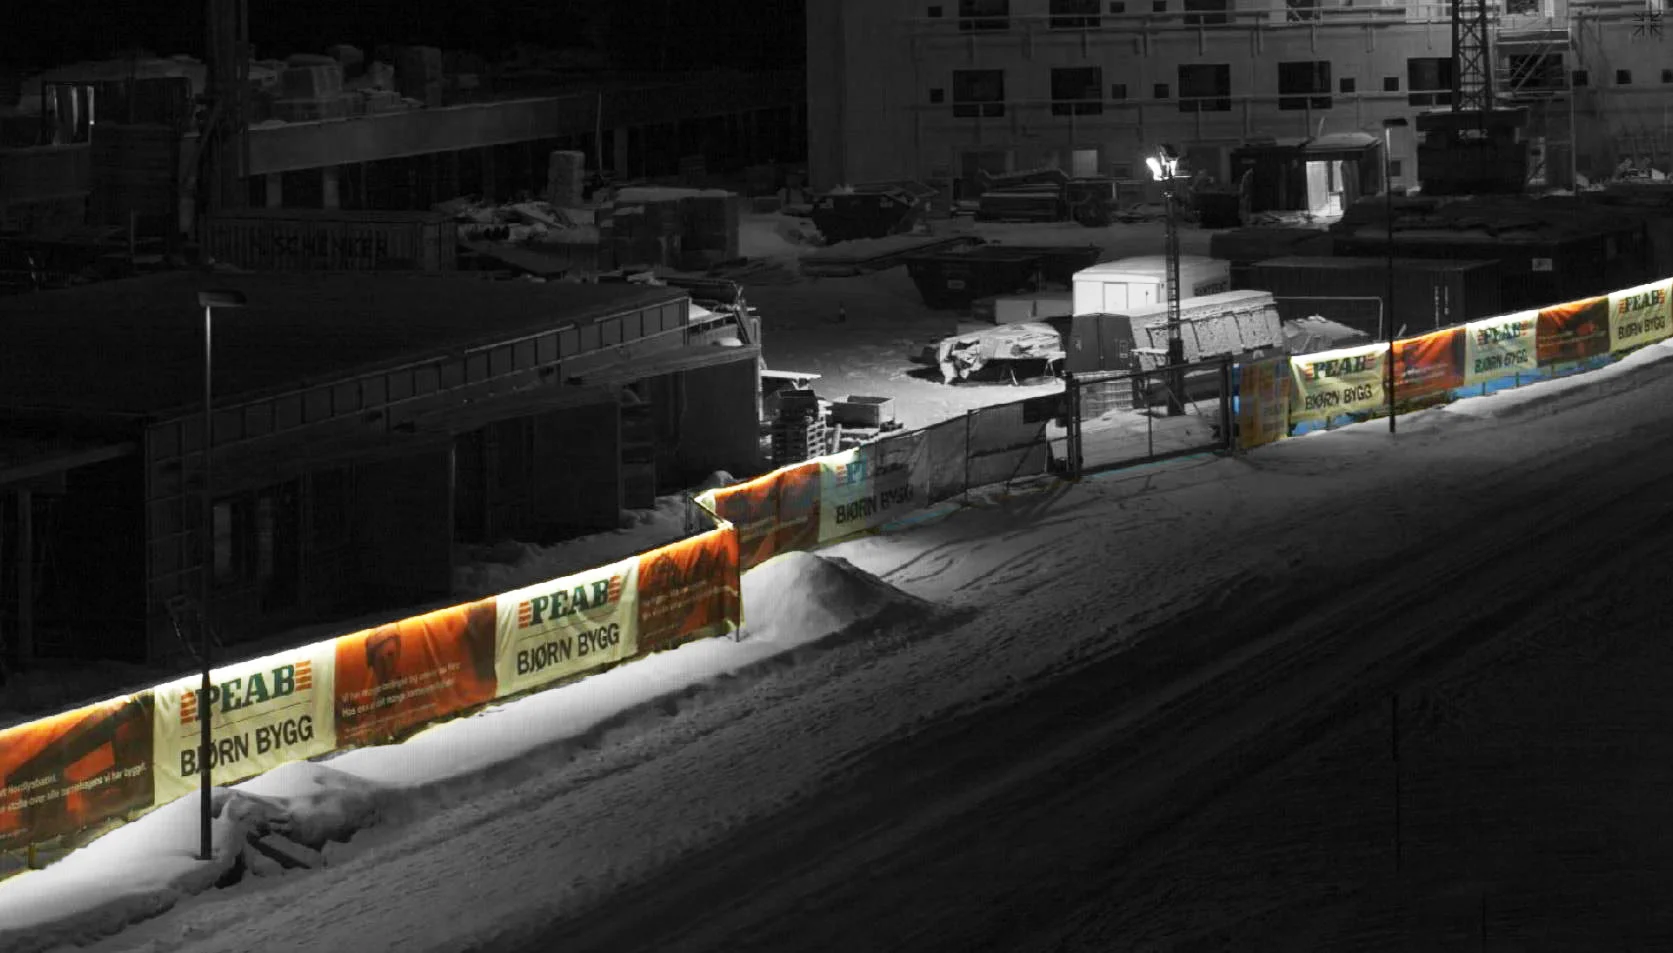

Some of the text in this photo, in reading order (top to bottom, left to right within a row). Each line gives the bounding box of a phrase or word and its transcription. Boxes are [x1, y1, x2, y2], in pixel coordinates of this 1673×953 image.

[274, 231, 389, 257] SCHENKER
[1625, 289, 1659, 312] PEAB
[1313, 356, 1367, 380] PEAB
[1343, 383, 1373, 404] BYGG
[529, 579, 609, 627] PEAB
[517, 622, 620, 677] BJØRN BYGG
[194, 663, 295, 722] PEAB
[180, 731, 249, 777] BJØRN
[255, 714, 315, 756] BYGG
